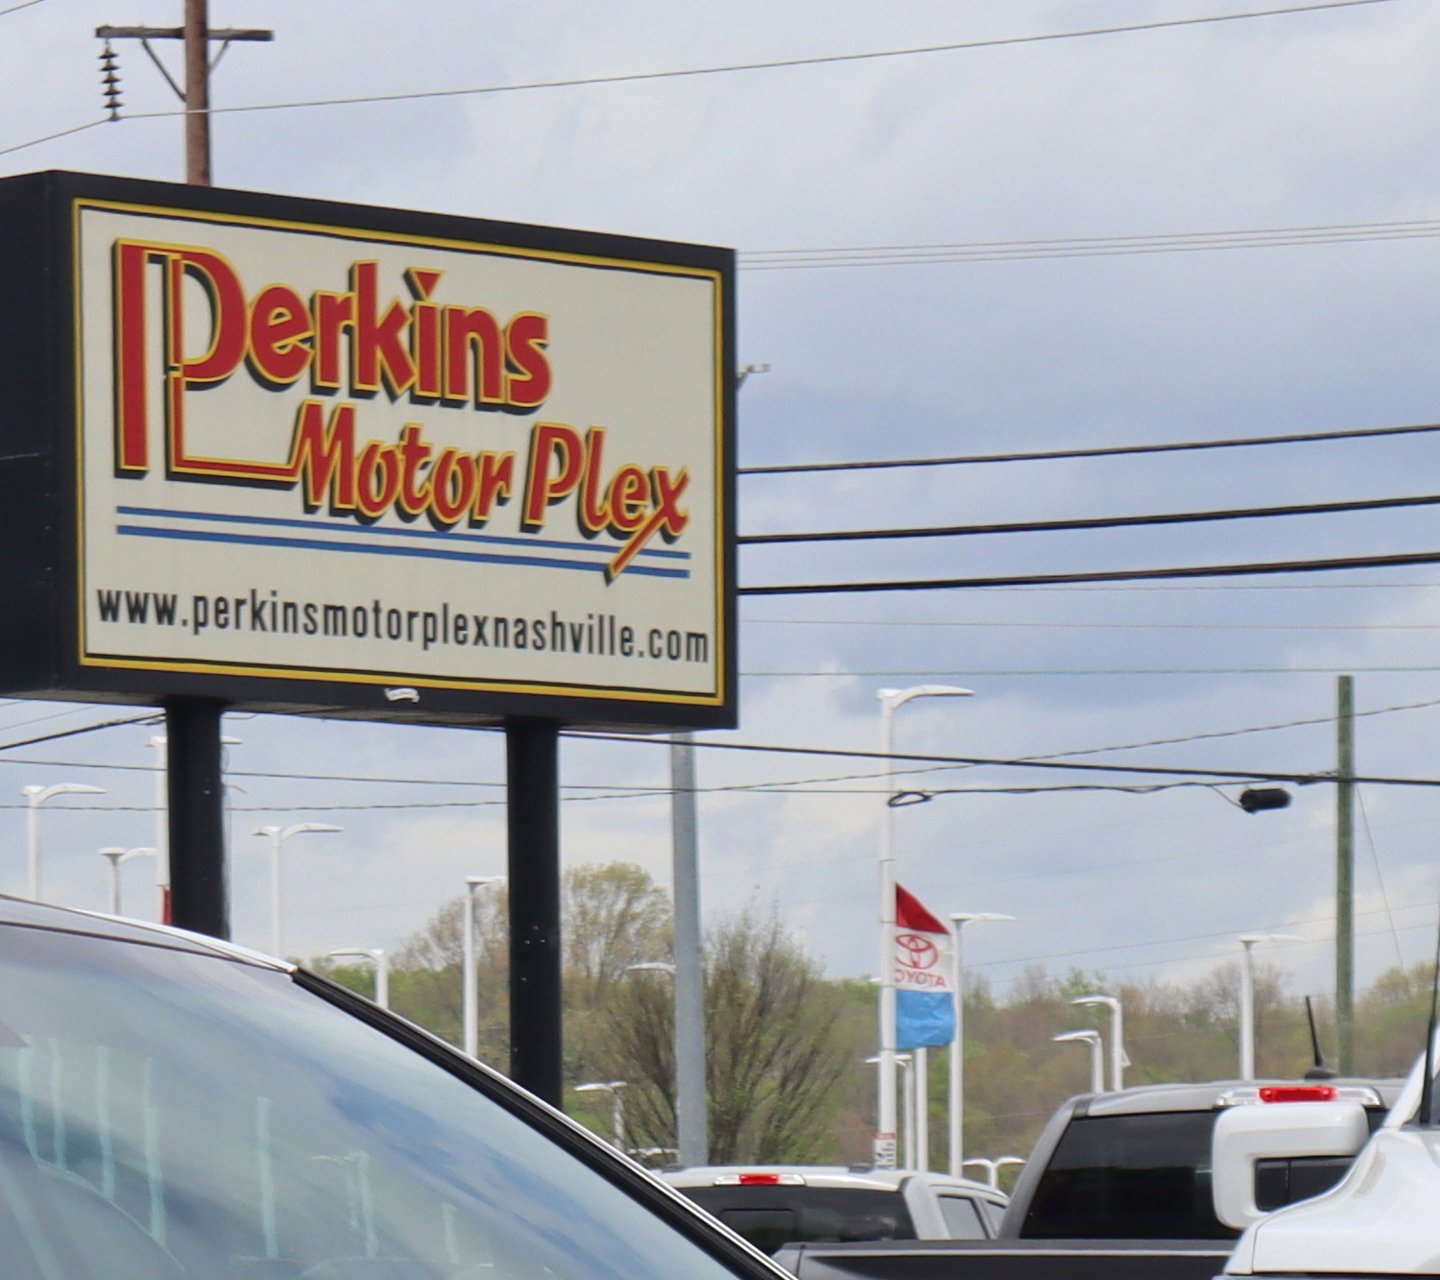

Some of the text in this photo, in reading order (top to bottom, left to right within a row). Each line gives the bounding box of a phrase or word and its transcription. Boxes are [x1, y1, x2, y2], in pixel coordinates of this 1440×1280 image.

[114, 238, 554, 474] Perkins
[96, 588, 710, 664] www.perkinsmotorplexnashville.com
[895, 968, 946, 987] OYOTA
